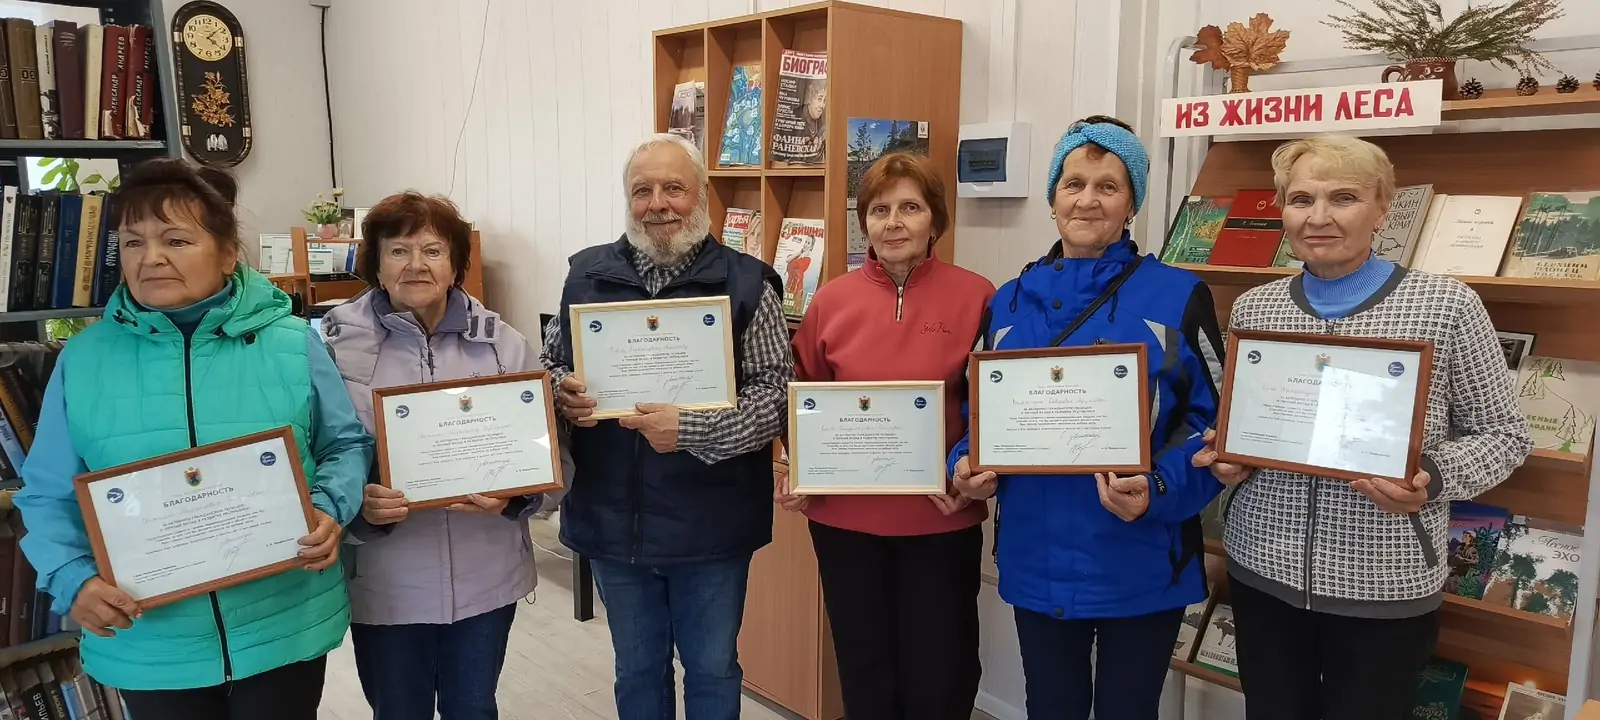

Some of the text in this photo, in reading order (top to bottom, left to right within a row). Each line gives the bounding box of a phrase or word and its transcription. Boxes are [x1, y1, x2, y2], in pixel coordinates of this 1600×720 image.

[220, 26, 227, 34] 2
[222, 36, 229, 44] 3
[117, 36, 125, 70] АНДРЕЕВ
[1175, 87, 1414, 129] ИЗ ЖИЗНИ ЛЕСА
[791, 226, 824, 238] ВИШНЯ
[627, 336, 681, 344] БЛАГОДАРНОСТЬ
[1287, 377, 1322, 386] БЛАГОДА
[1028, 388, 1087, 396] БЛАГОДАРНОСТЬ
[438, 416, 497, 428] БЛАГОДАРНОСТЬ
[1527, 415, 1558, 424] ЕСНЫЕ
[162, 487, 234, 508] БЛАГОДАРНОСТЬ
[1532, 536, 1579, 551] Лесное
[1552, 550, 1580, 563] ЭХО
